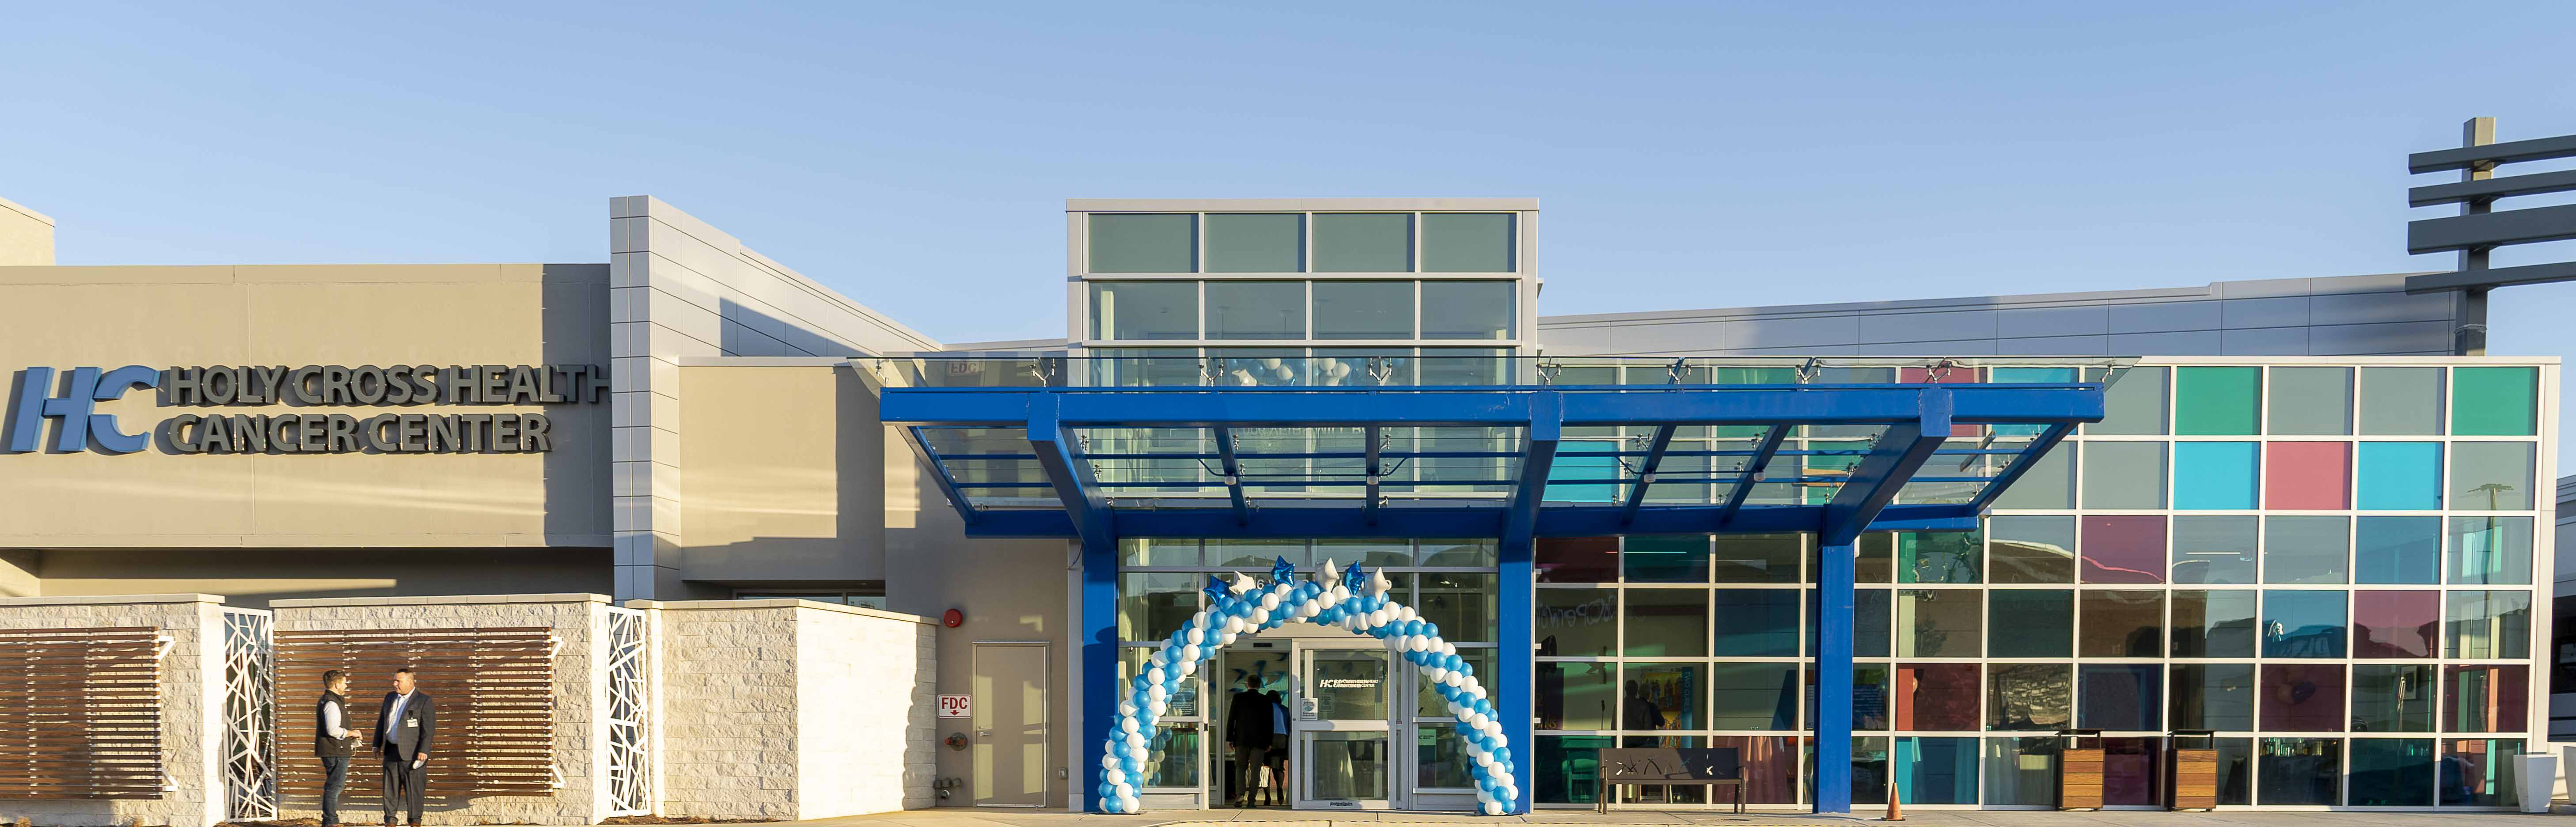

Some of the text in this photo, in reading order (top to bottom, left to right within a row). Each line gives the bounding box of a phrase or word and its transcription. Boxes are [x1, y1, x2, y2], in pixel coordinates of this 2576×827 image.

[170, 364, 612, 404] HOLY CROSS HEALTH
[11, 365, 160, 453] HC
[169, 414, 552, 452] CANCER CENTER
[1319, 679, 1334, 688] HC
[941, 697, 967, 709] FDC
